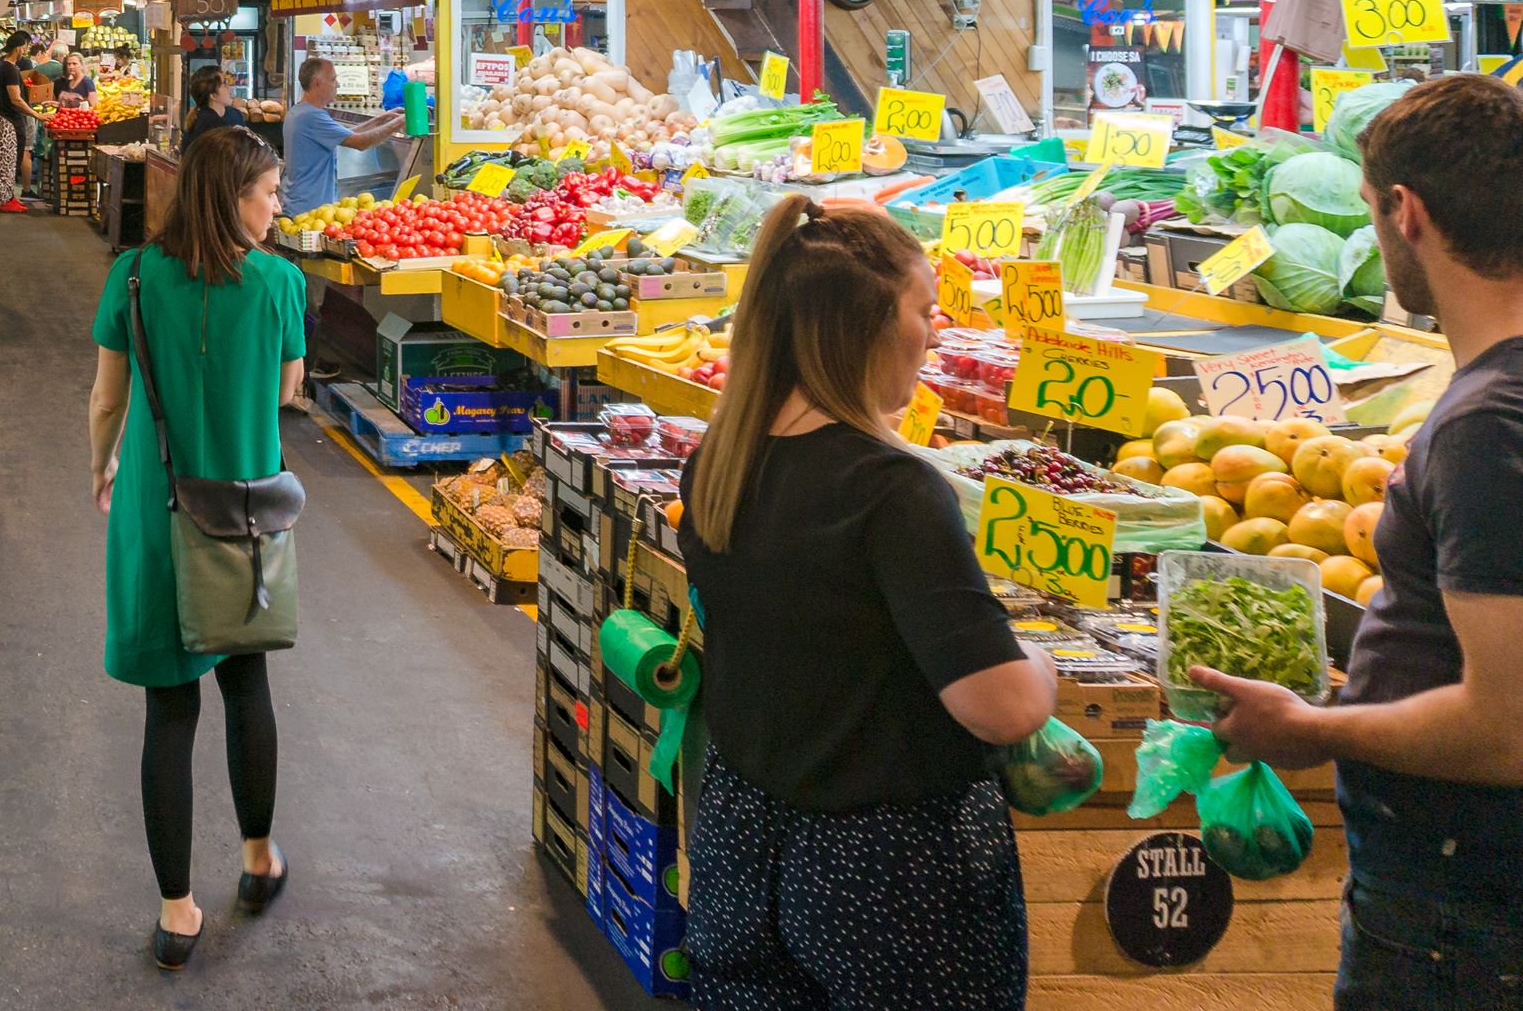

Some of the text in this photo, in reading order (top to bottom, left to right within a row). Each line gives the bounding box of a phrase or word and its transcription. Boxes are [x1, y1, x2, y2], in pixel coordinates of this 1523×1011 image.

[1095, 51, 1129, 63] CHOOSE
[1129, 51, 1141, 63] SA
[1042, 349, 1110, 370] CHERRIES
[1098, 340, 1134, 362] Hills
[1199, 348, 1278, 374] Very Sweet
[985, 487, 1027, 570] 2
[1058, 513, 1105, 536] BERRIES
[1136, 847, 1207, 878] STALL
[1151, 888, 1189, 928] 52
